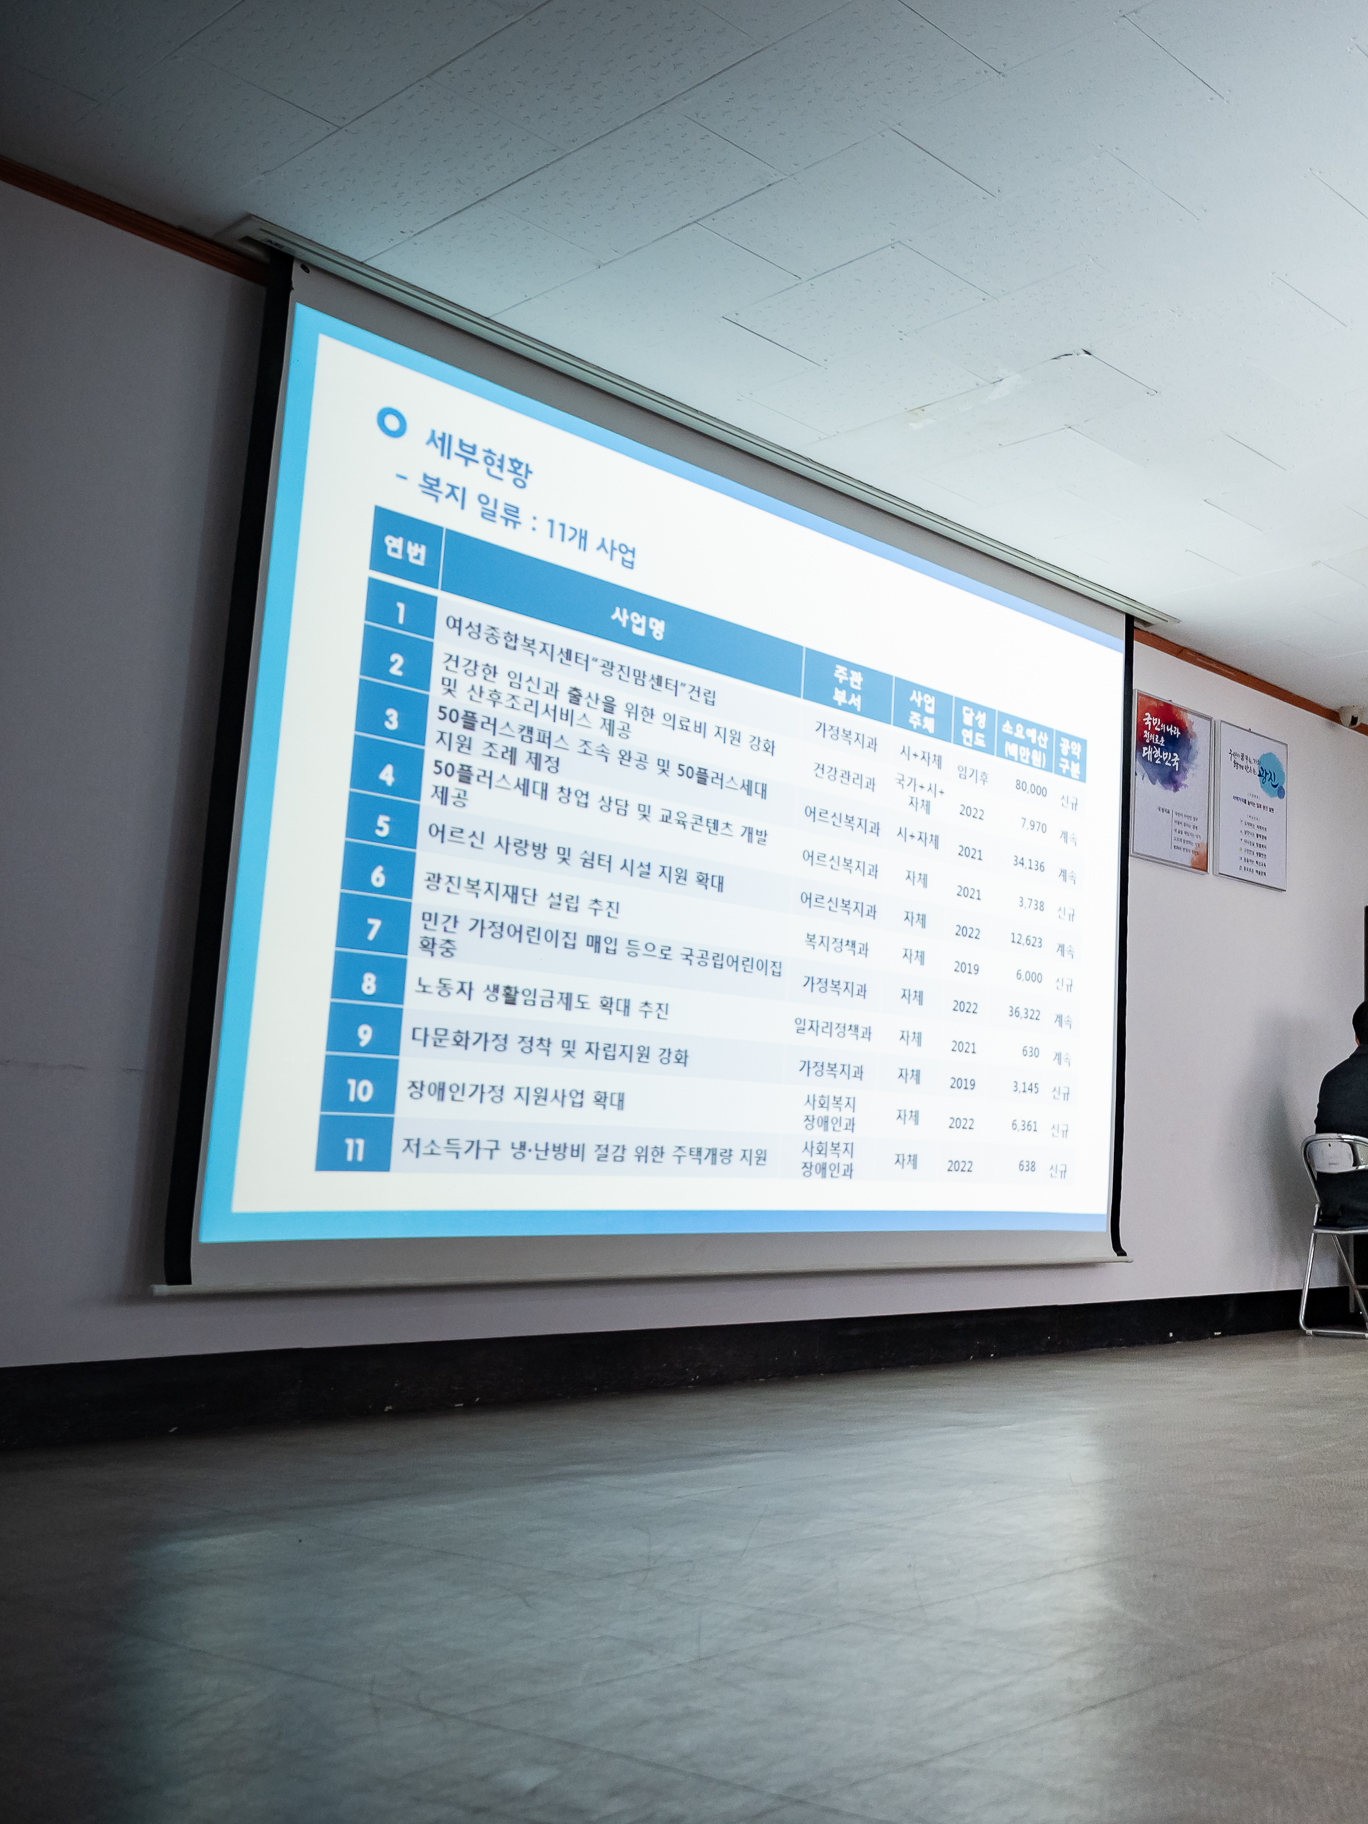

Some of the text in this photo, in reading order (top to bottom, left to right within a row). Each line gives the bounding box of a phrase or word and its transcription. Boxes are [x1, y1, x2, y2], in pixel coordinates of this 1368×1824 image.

[425, 428, 533, 489] 세부현황
[418, 471, 466, 510] 복지
[476, 492, 521, 530] 일류
[546, 518, 588, 552] 11개
[595, 536, 636, 570] 사업
[383, 534, 426, 566] 연번
[395, 601, 405, 625] 1
[610, 605, 665, 641] 사업명
[388, 652, 404, 676] 2
[833, 663, 863, 691] 주관
[440, 675, 631, 740] 및 산후조리서비스 제공
[442, 652, 775, 756] 건강한 임신과 출산을 위한 의료비 지원 강화
[831, 686, 861, 712] 부서
[908, 688, 935, 715] 사업
[383, 707, 399, 730] 3
[814, 720, 877, 753] 가정복지과
[435, 729, 560, 774] 지원 조례 제정
[436, 704, 767, 800] 50플러스캠퍼스 조속 완공 및 50플러스세대
[899, 744, 942, 770] 시+자체
[1141, 745, 1181, 772] 대한민국
[378, 763, 395, 787] 4
[813, 761, 875, 792] 건강관리과
[1257, 766, 1279, 788] 광진
[430, 784, 469, 808] 제공
[432, 758, 768, 845] 50플러스세대 창업 상담 및 교육콘텐츠 개발
[907, 795, 931, 815] 자체
[803, 805, 880, 837] 어르신복지과
[958, 803, 984, 821] 2022
[374, 813, 391, 837] 5
[896, 826, 939, 850] 시+자체
[427, 822, 724, 893] 어르신 사랑방 및 쉼터 시설 지원 확대
[801, 849, 878, 879] 어르신복지과
[957, 843, 983, 861] 2021
[370, 864, 386, 888] 6
[904, 869, 928, 889] 자체
[424, 871, 619, 919] 광진복지재단 설립 추진
[955, 884, 981, 901] 2021
[799, 891, 877, 920] 어르신복지과
[366, 917, 382, 941] 7
[903, 910, 926, 929] 자체
[954, 923, 981, 940] 2022
[420, 910, 782, 977] 민간 가정어린이집 매입 등으로 국공립어린이집
[804, 931, 869, 958] 복지정책과
[901, 947, 925, 966] 자체
[953, 960, 979, 975] 2019
[360, 971, 377, 995] 8
[802, 975, 867, 999] 가정복지과
[414, 976, 668, 1020] 노동자 생활임금제도 확대 추진
[900, 987, 924, 1006] 자체
[951, 999, 978, 1014] 2022
[357, 1023, 373, 1047] 9
[793, 1016, 872, 1041] 일자리정책과
[898, 1029, 922, 1047] 자체
[410, 1026, 688, 1067] 다문화가정 정착 및 자립지원 강화
[950, 1039, 976, 1054] 2021
[1021, 1044, 1040, 1058] 630
[798, 1059, 864, 1081] 가정복지과
[897, 1067, 921, 1085] 자체
[346, 1077, 374, 1102] 10
[407, 1079, 625, 1110] 장애인가정 지원사업 확대
[949, 1076, 976, 1090] 2019
[804, 1093, 856, 1113] 사회복지
[802, 1114, 855, 1133] 장애인과
[895, 1108, 919, 1125] 자체
[948, 1116, 974, 1130] 2022
[344, 1137, 365, 1162] 11
[401, 1137, 500, 1160] 저소득가구
[594, 1143, 627, 1163] 절감
[633, 1144, 665, 1164] 위한
[672, 1145, 733, 1165] 주택개량
[739, 1148, 767, 1166] 지원
[801, 1139, 854, 1158] 사회복지
[800, 1160, 854, 1179] 장애인과
[893, 1152, 918, 1170] 자체
[946, 1159, 973, 1173] 2022
[1017, 1159, 1036, 1172] 638
